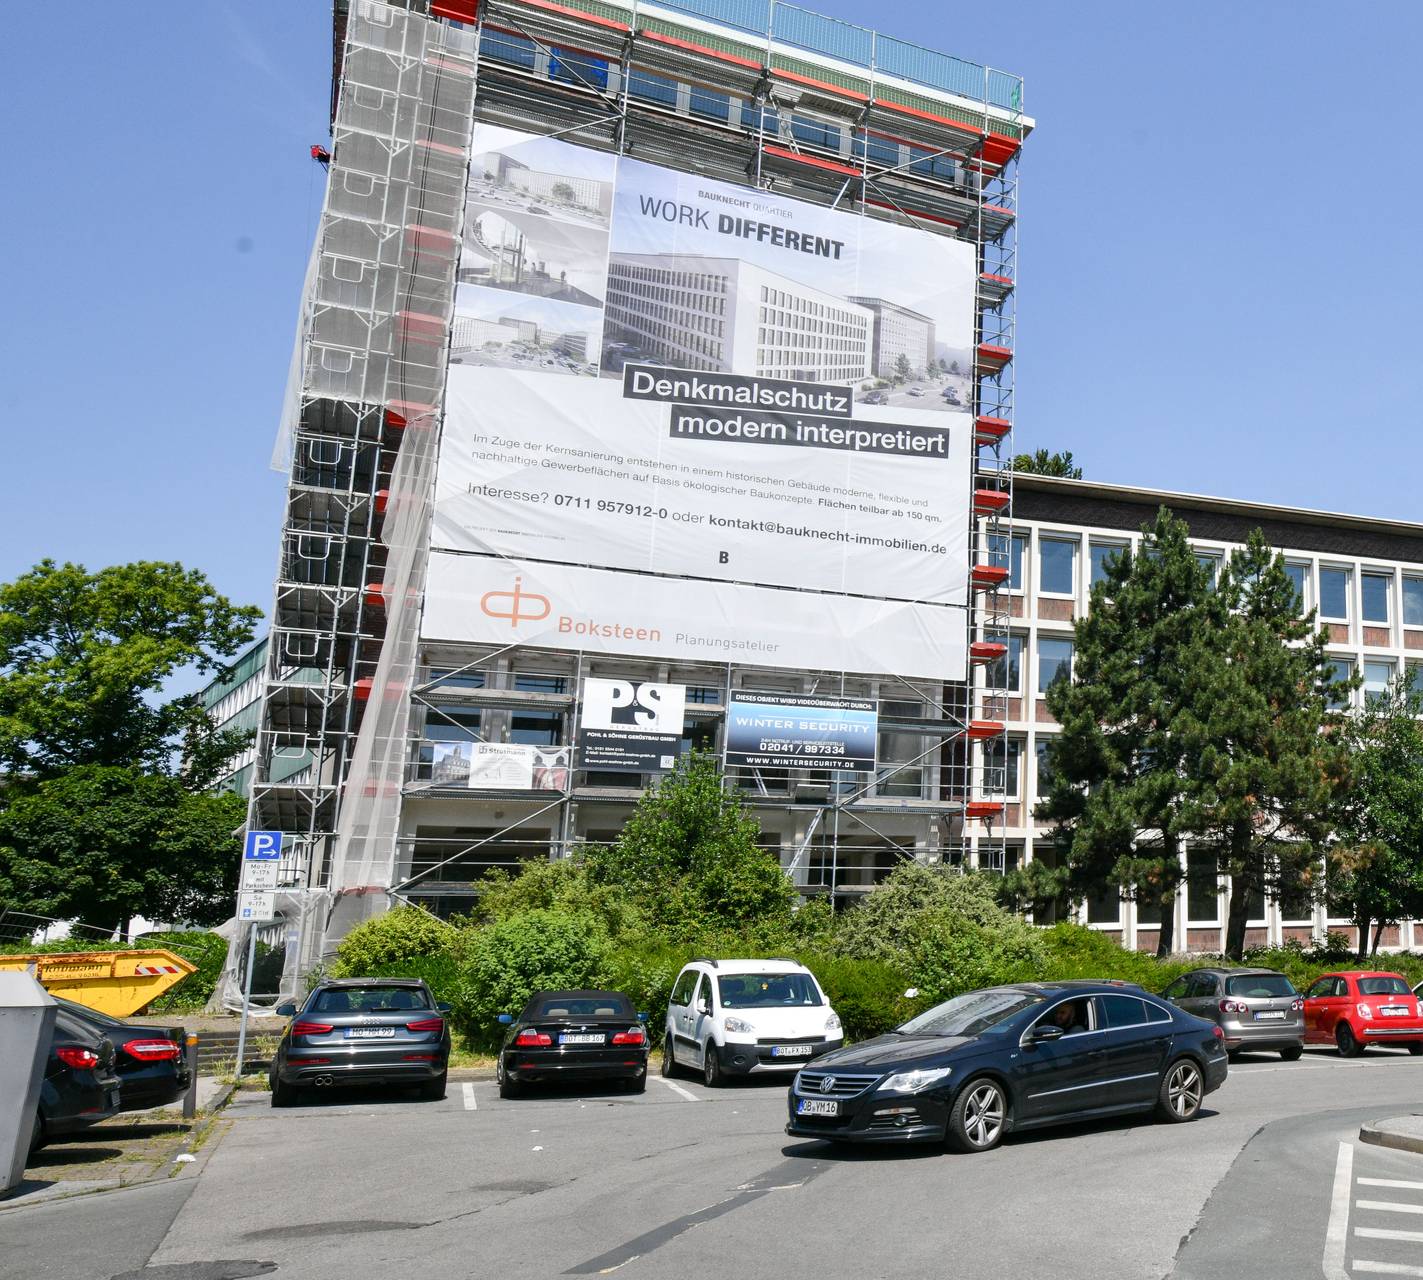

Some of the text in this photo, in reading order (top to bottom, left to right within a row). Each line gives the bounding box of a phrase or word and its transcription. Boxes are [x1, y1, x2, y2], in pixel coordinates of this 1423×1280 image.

[698, 190, 792, 220] BAUKNECHT QUARTIER
[640, 195, 844, 260] WORK DIFFERENT
[632, 371, 848, 412] Denkmalschutz
[678, 414, 945, 453] modern interpretiert
[472, 451, 538, 466] nachhaltige
[541, 458, 630, 480] Gewerbeflächen
[632, 473, 650, 484] auf
[652, 476, 680, 487] Basis
[683, 478, 747, 496] ökologischer
[818, 498, 856, 511] Flächen
[859, 504, 889, 515] teilbar
[892, 508, 904, 518] ab
[906, 510, 922, 520] 150
[924, 514, 942, 524] qm.
[473, 434, 928, 508] Im Zuge der Kernsanierung entstehen in einem historischen Gebäude moderne, flexible und
[468, 482, 947, 554] Interesse? 0711 957912-0 oder kontakt@bauknecht-immobilien.de
[718, 550, 729, 564] B
[558, 616, 780, 653] Boksteen Planungsatelier
[797, 698, 850, 708] VIDEOÜBERWACHT
[736, 717, 870, 734] WINTER SECURITY
[746, 757, 854, 768] WWW.WINTERSECURITY.DE
[760, 742, 793, 752] 02041
[796, 744, 803, 754] /
[254, 835, 273, 856] P
